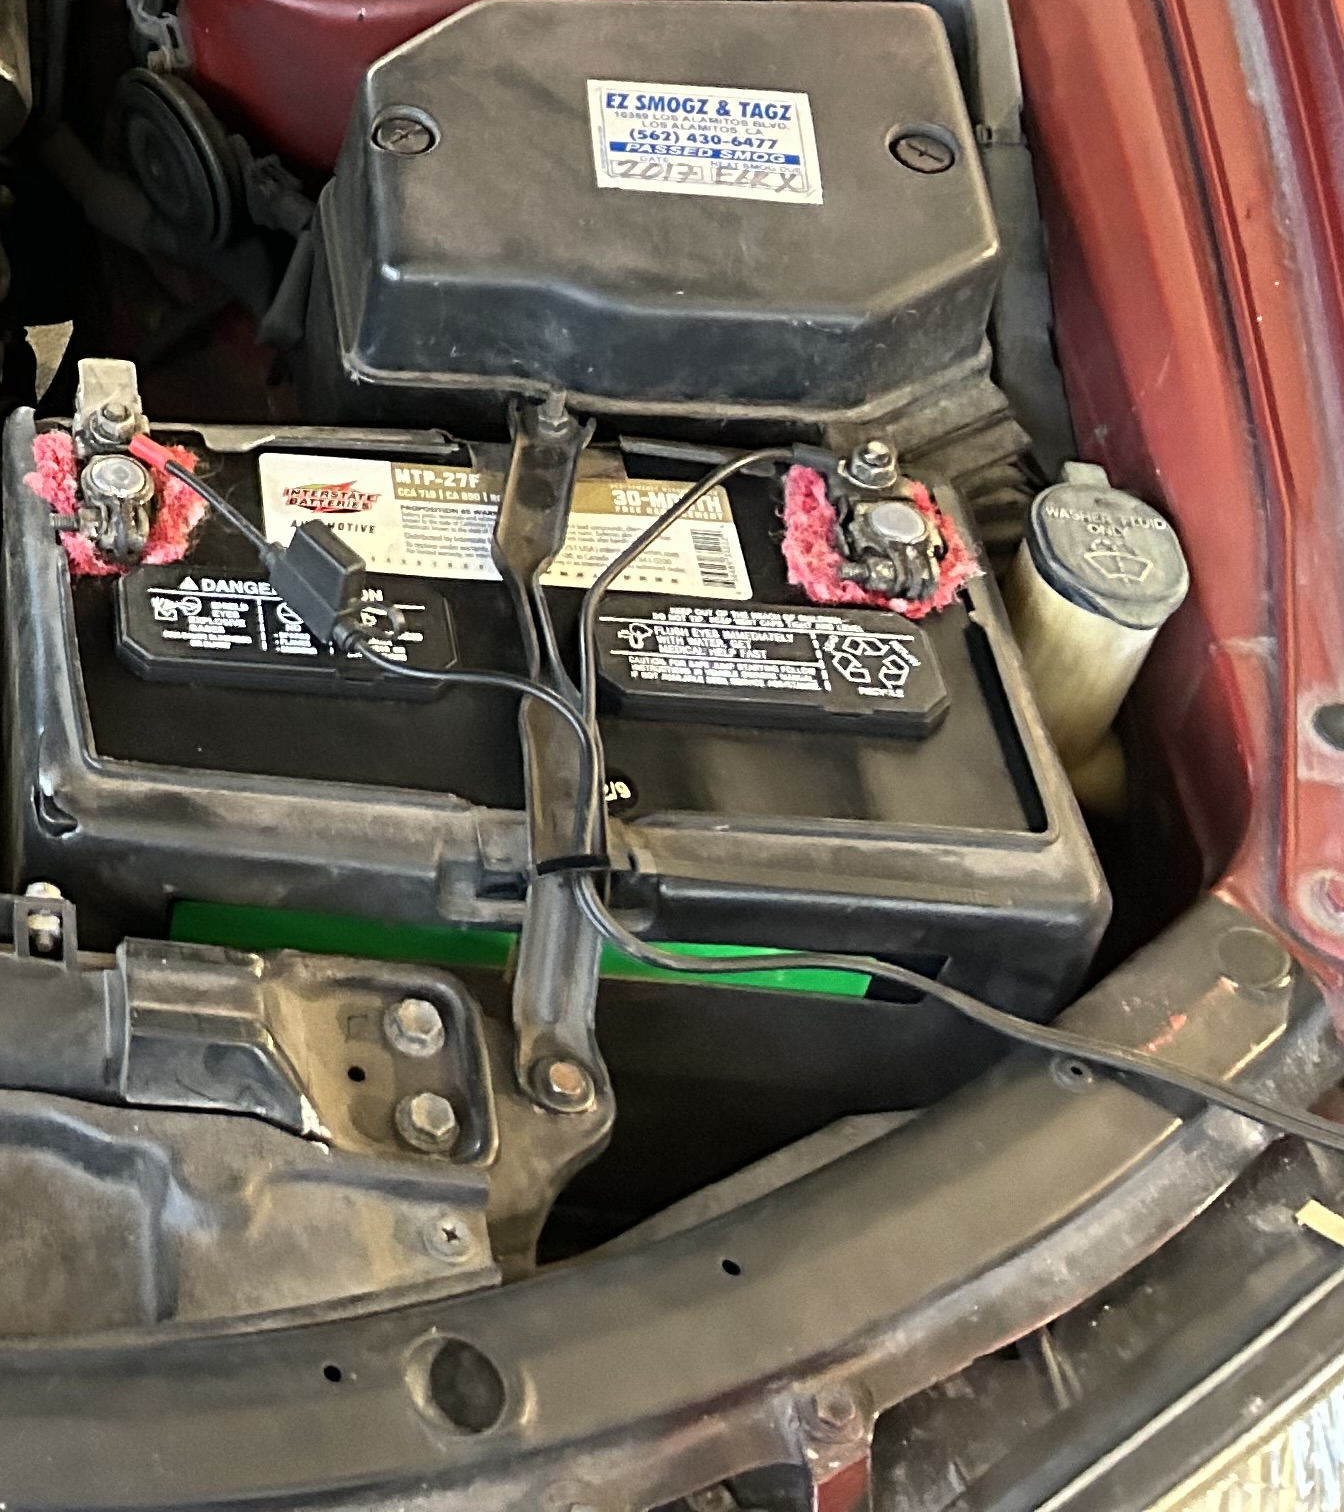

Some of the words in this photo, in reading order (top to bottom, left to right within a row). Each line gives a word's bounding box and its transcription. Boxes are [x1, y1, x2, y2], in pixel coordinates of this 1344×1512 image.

[606, 92, 630, 110] EZ
[635, 94, 709, 115] SMOGZ
[715, 99, 731, 116] &
[739, 101, 792, 121] TAGZ
[642, 120, 668, 129] LOS
[745, 128, 764, 136] CA
[653, 113, 679, 122] LOS
[682, 116, 749, 127] ALAMITOS
[629, 128, 680, 145] (562)
[686, 133, 778, 150] 430-6477
[625, 143, 713, 157] PASSED
[719, 149, 786, 163] SMOG
[395, 468, 482, 489] MTP-27F
[284, 488, 376, 502] INTERSTATE
[287, 497, 372, 511] BATTERIES
[1045, 506, 1112, 524] WASHER
[1120, 516, 1167, 530] FLUID
[1087, 523, 1129, 537] ONLY
[201, 577, 279, 597] DANGE
[654, 626, 689, 637] FLUSH
[691, 628, 721, 639] EYES
[722, 630, 794, 644] IMMEDIATELY
[656, 635, 685, 646] WITH
[658, 644, 707, 656] MEDICAL
[709, 647, 737, 658] HELP
[739, 649, 768, 660] FAST
